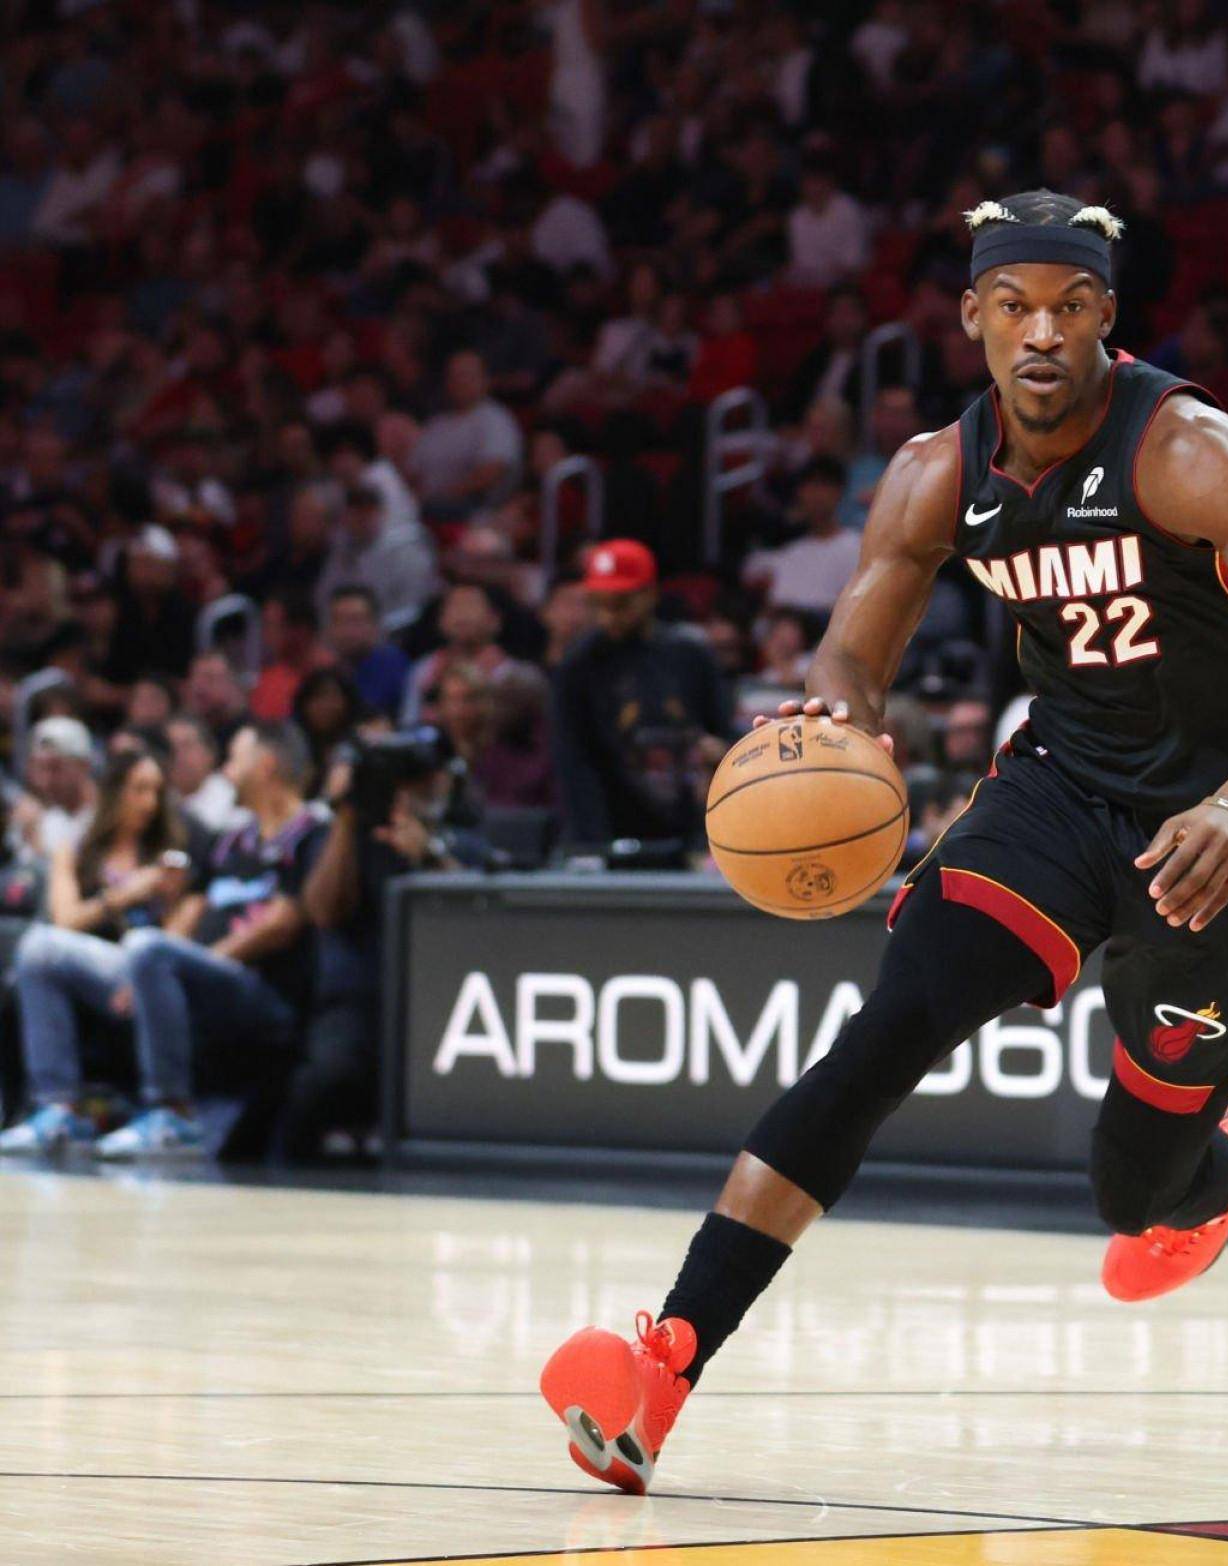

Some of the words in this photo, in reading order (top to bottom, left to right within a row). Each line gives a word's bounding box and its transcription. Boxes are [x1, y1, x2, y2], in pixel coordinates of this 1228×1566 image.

[1067, 506, 1118, 518] Robinhood
[964, 534, 1144, 601] MIAMI
[1060, 595, 1160, 667] 22
